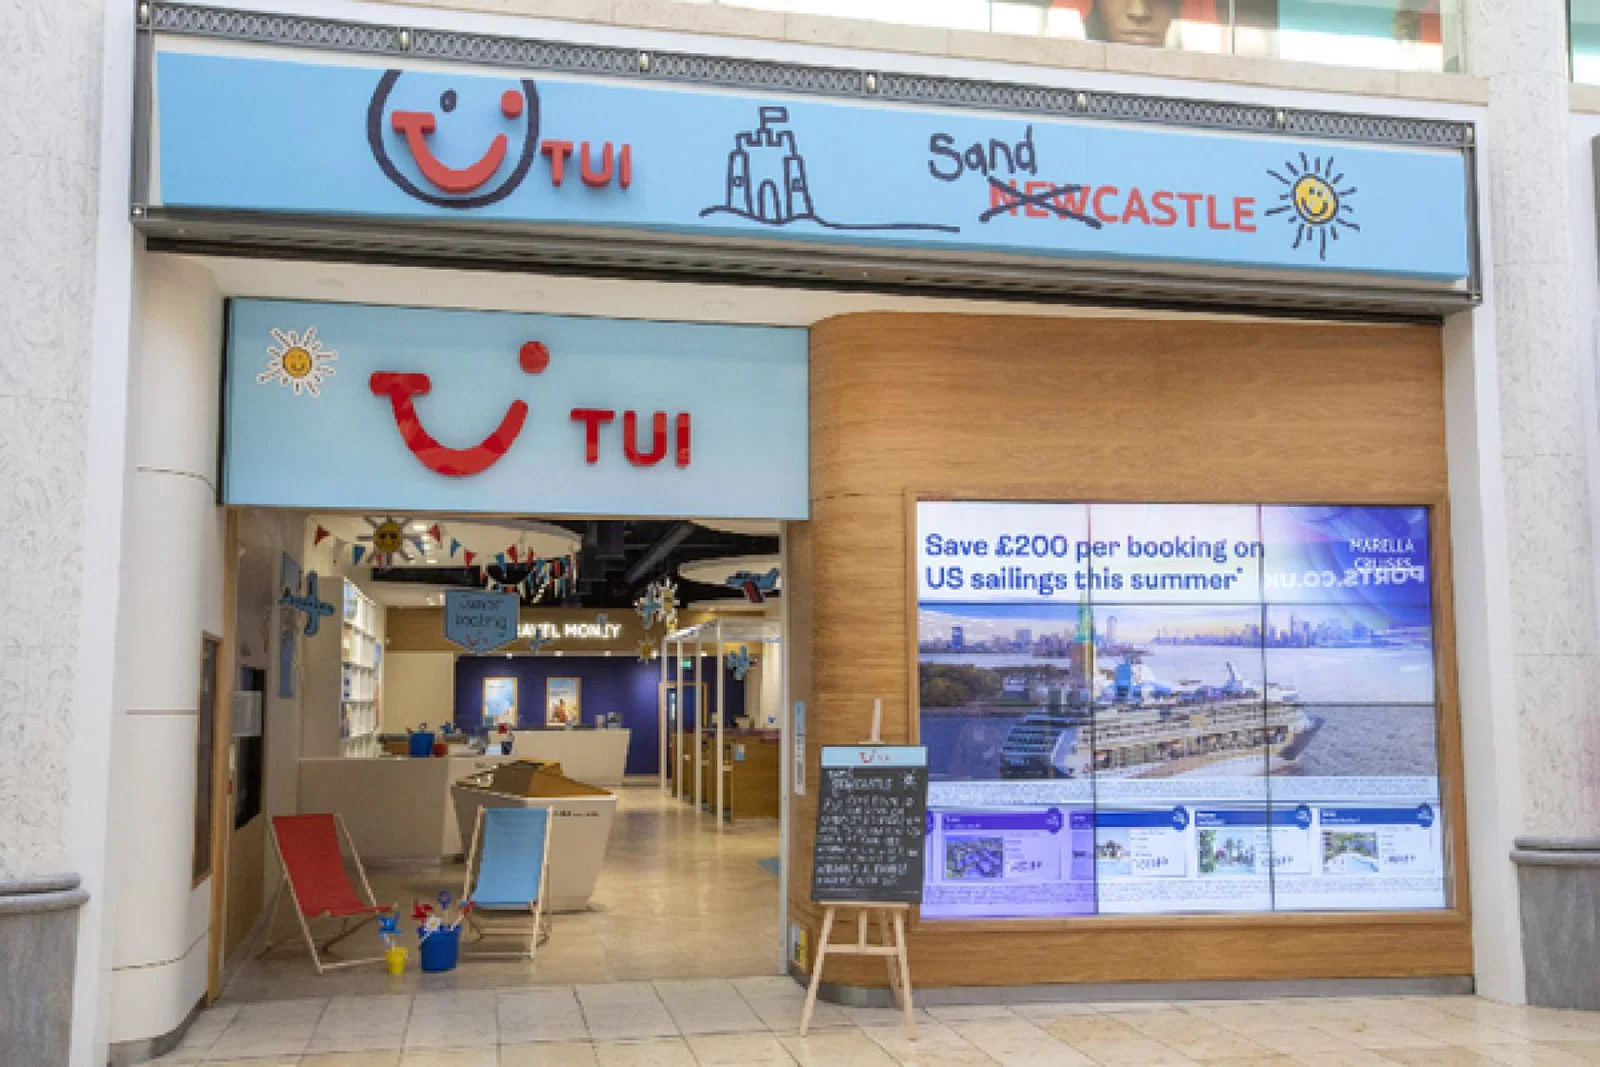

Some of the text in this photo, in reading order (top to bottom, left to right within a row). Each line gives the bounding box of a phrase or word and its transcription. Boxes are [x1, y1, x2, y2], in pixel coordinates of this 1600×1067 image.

[541, 140, 632, 189] TUI
[928, 124, 1037, 182] Sand
[989, 179, 1257, 233] NEWCASTLE
[570, 408, 691, 467] TUI
[925, 533, 1265, 563] Save £200 per booking on
[1348, 538, 1415, 553] MARELLA
[925, 566, 964, 590] US
[970, 566, 1069, 595] sailings
[1075, 567, 1123, 590] this
